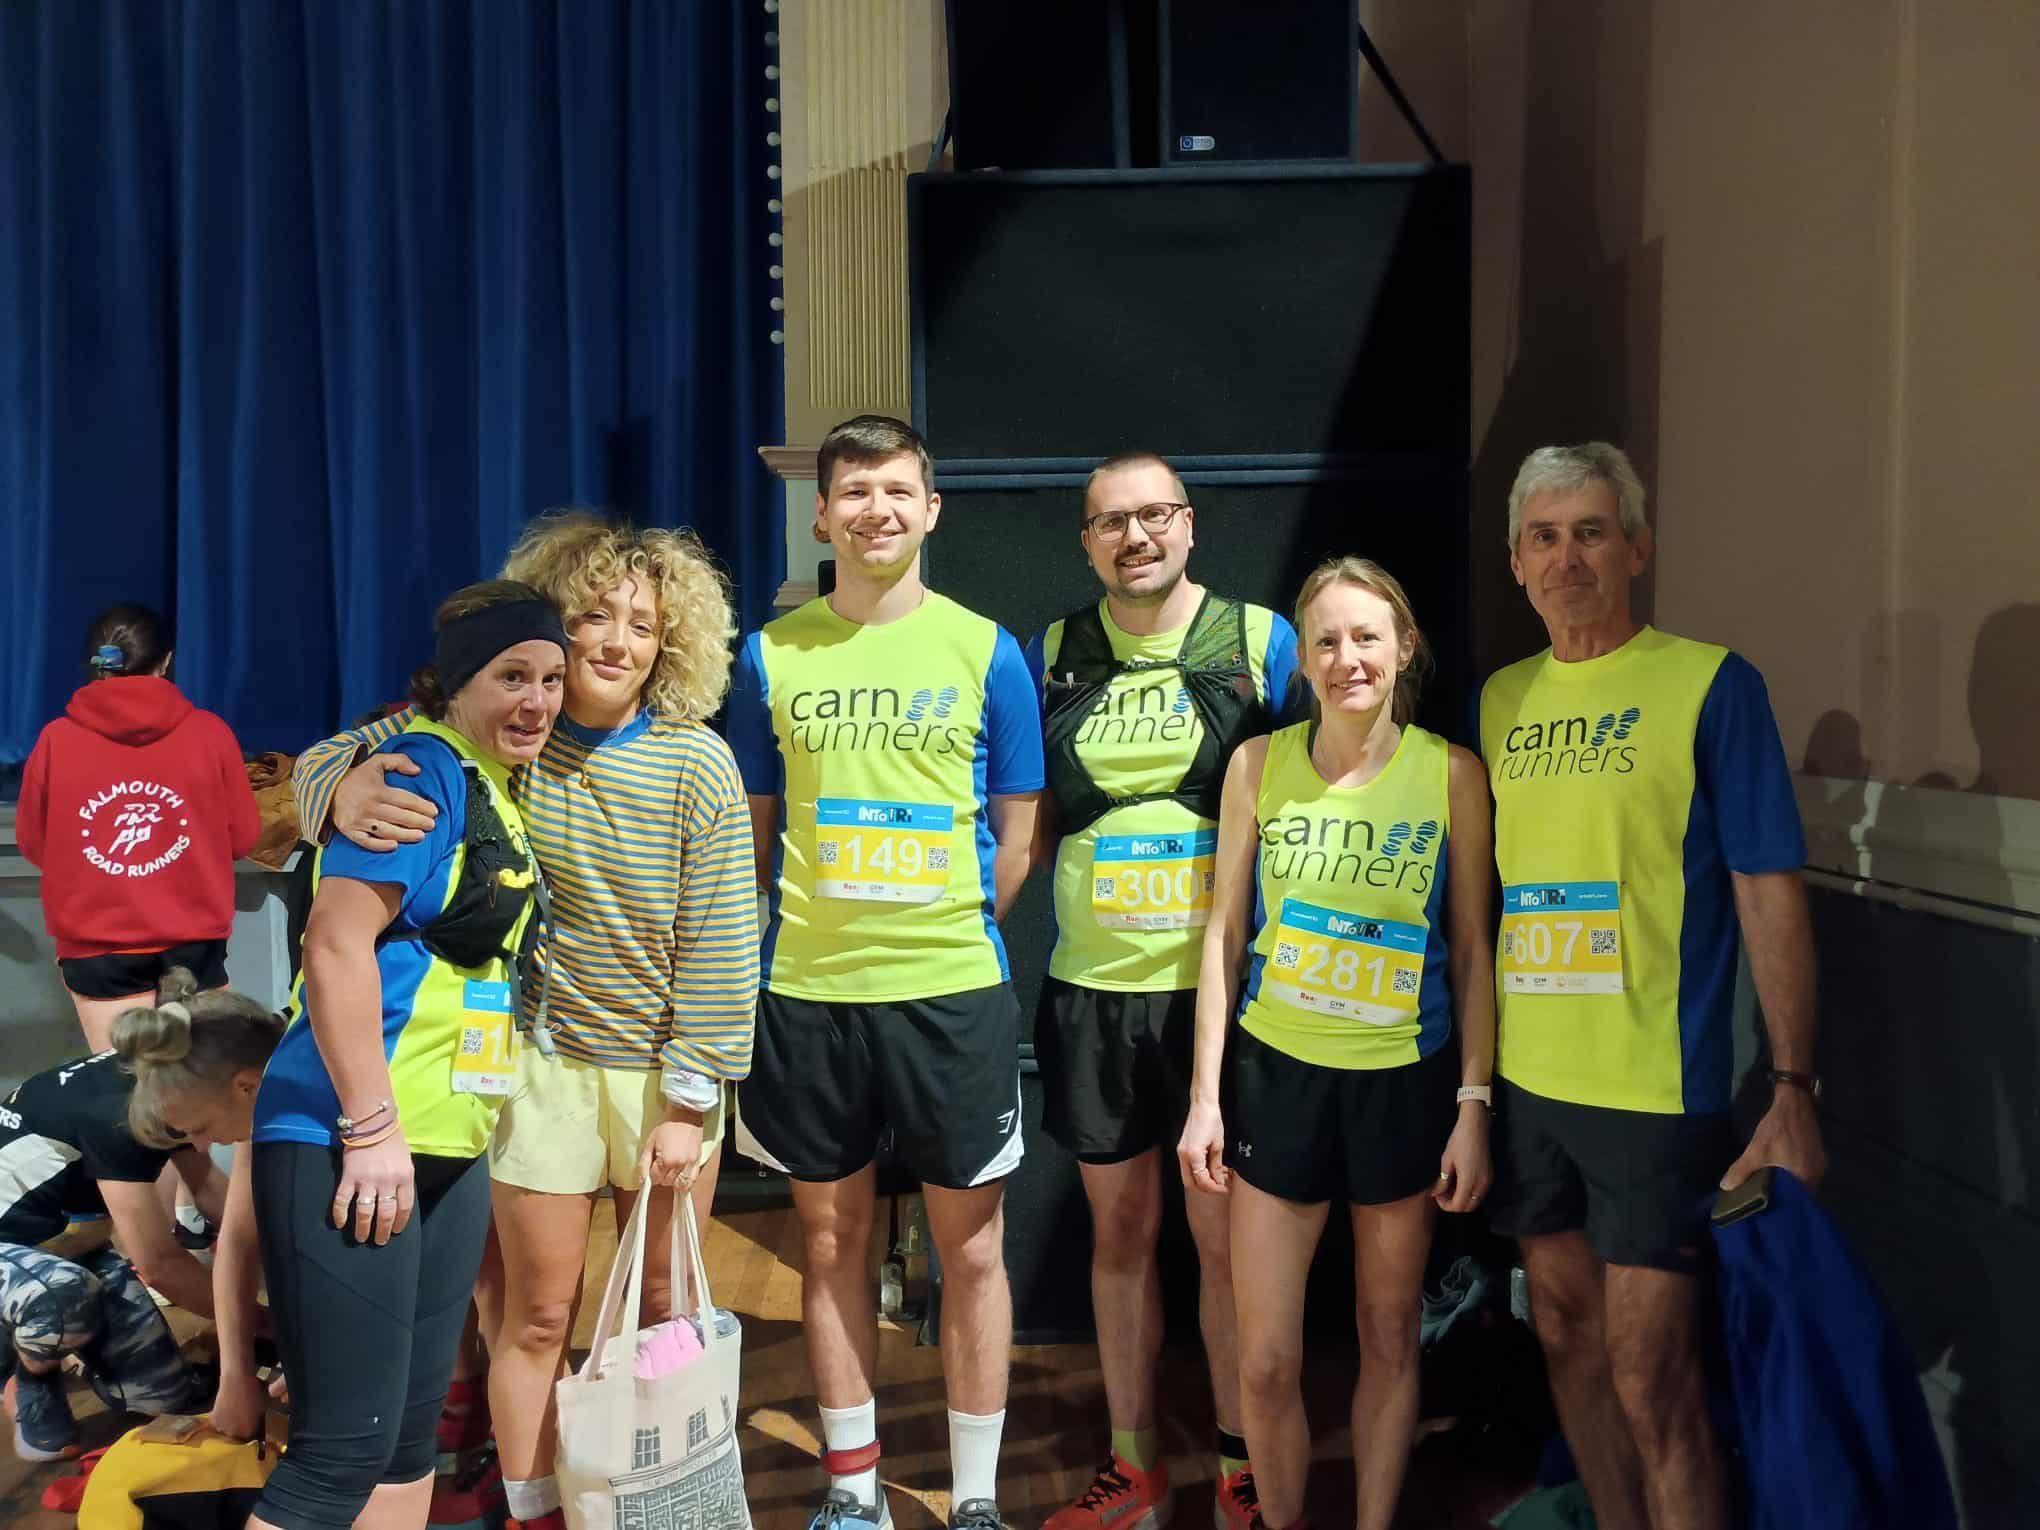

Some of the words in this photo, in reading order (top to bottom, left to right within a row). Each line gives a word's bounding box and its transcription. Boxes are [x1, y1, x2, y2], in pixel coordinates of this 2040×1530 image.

[790, 687, 899, 722] carn
[1092, 685, 1166, 716] arn
[790, 721, 959, 753] runners
[1074, 712, 1200, 744] unner
[1506, 716, 1587, 753] carn
[1499, 744, 1637, 782] runners
[79, 780, 184, 820] FALMOUTH
[1263, 815, 1374, 851] carn
[82, 846, 124, 876] ROAD
[127, 834, 190, 878] RUNNERS
[844, 834, 923, 877] 149
[1262, 848, 1433, 894] runners
[1120, 867, 1200, 907] 300
[1513, 921, 1583, 965] 607
[1300, 944, 1386, 998] 281
[0, 1105, 23, 1130] RS
